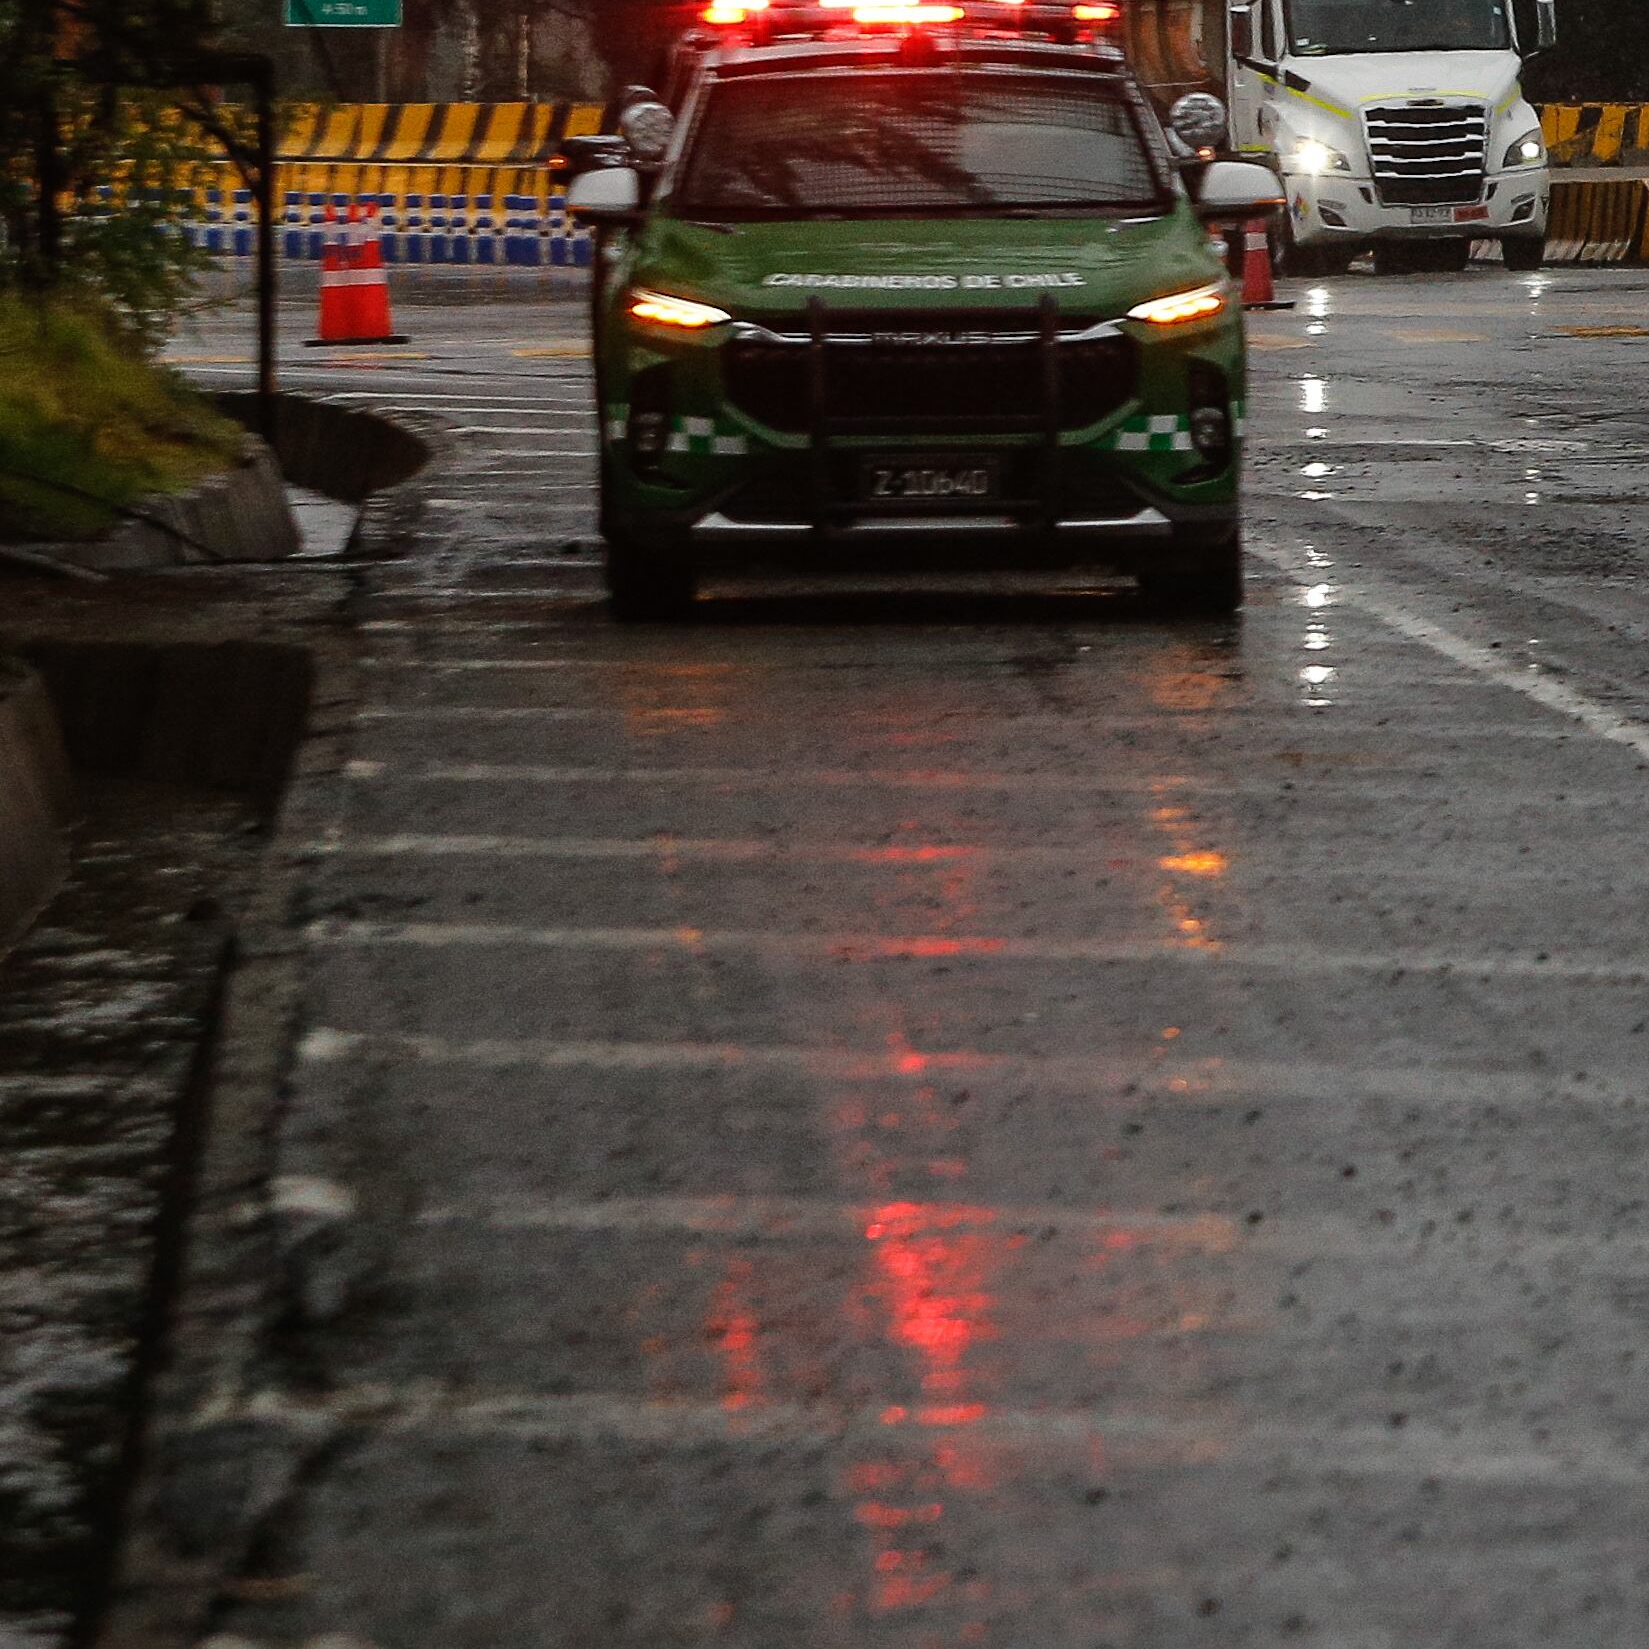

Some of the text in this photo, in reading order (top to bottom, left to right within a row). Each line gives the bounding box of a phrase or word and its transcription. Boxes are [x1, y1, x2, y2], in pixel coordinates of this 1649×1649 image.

[763, 272, 1087, 289] CARABINEROS DE CHILE
